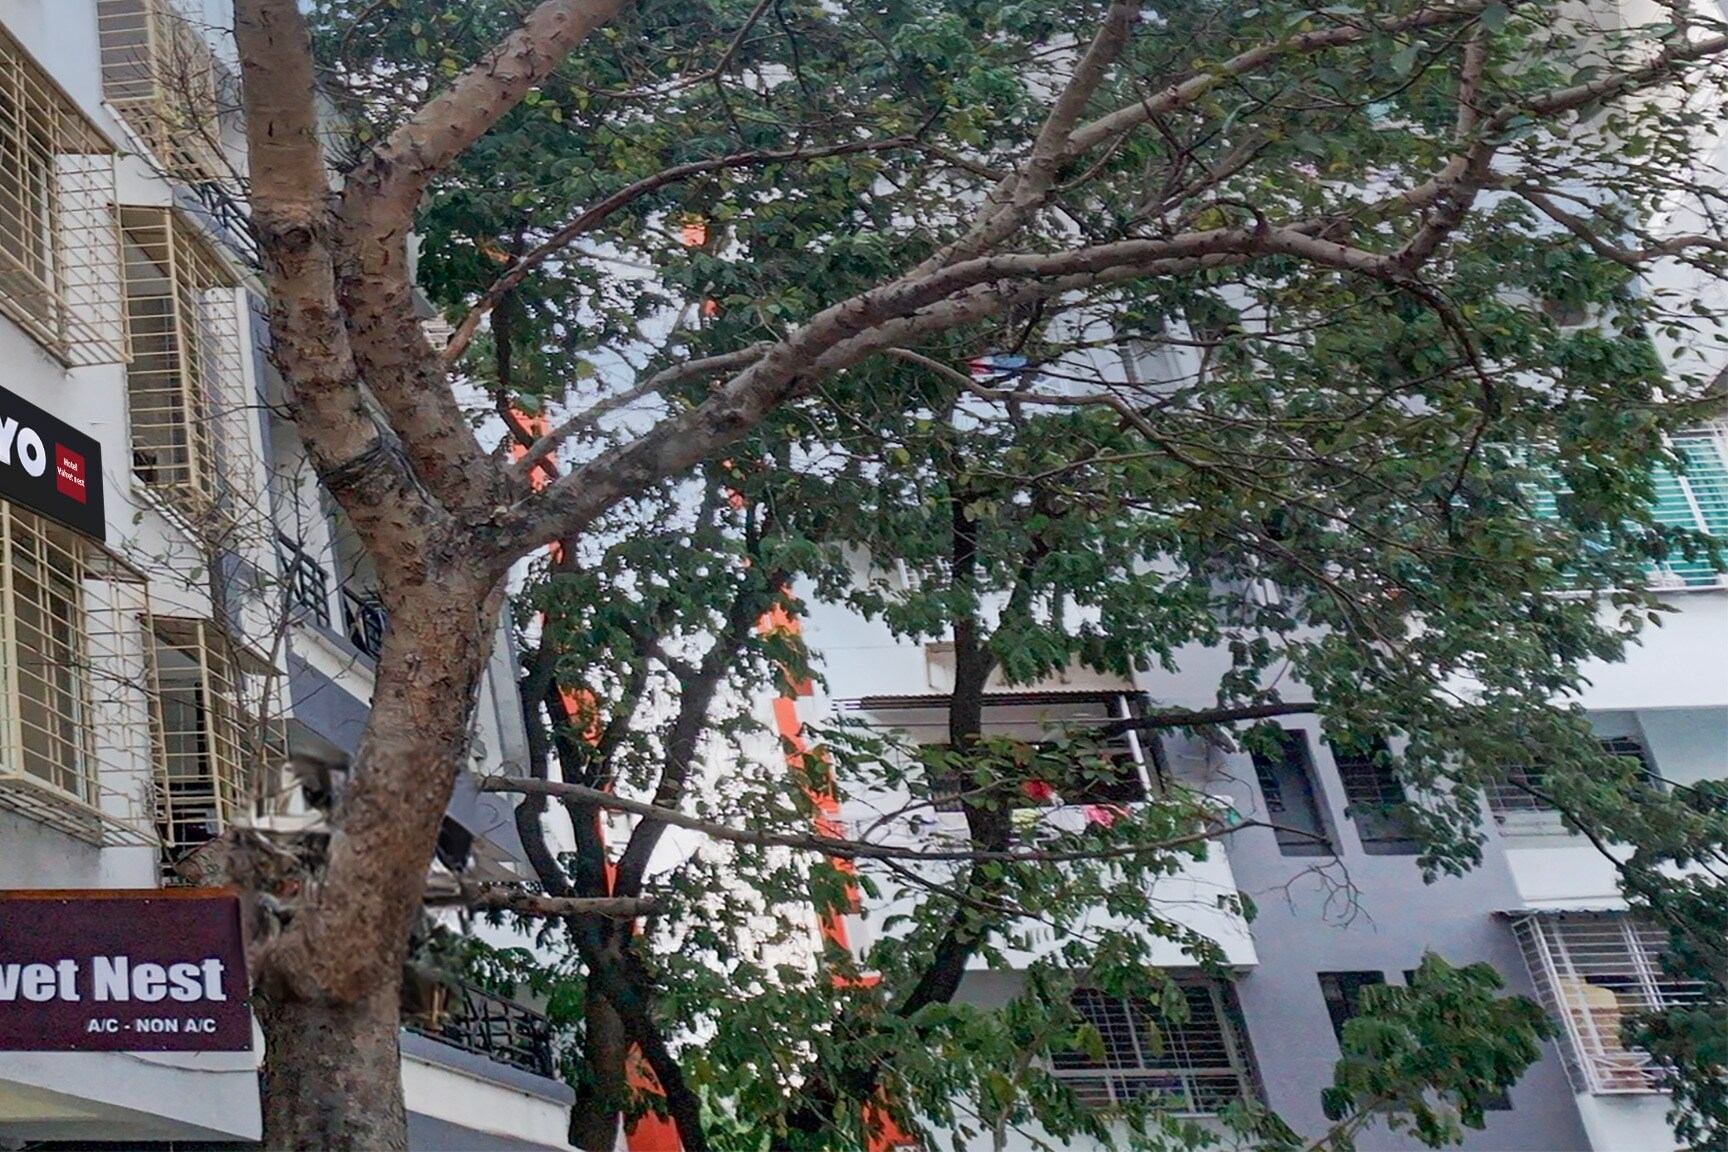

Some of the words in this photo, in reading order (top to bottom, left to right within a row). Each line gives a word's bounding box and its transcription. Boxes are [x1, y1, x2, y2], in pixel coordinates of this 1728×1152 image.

[63, 457, 78, 472] Hotel
[93, 955, 227, 1002] Nest
[87, 1018, 119, 1033] A/C
[136, 1018, 179, 1033] NON
[184, 1018, 216, 1033] A/C
